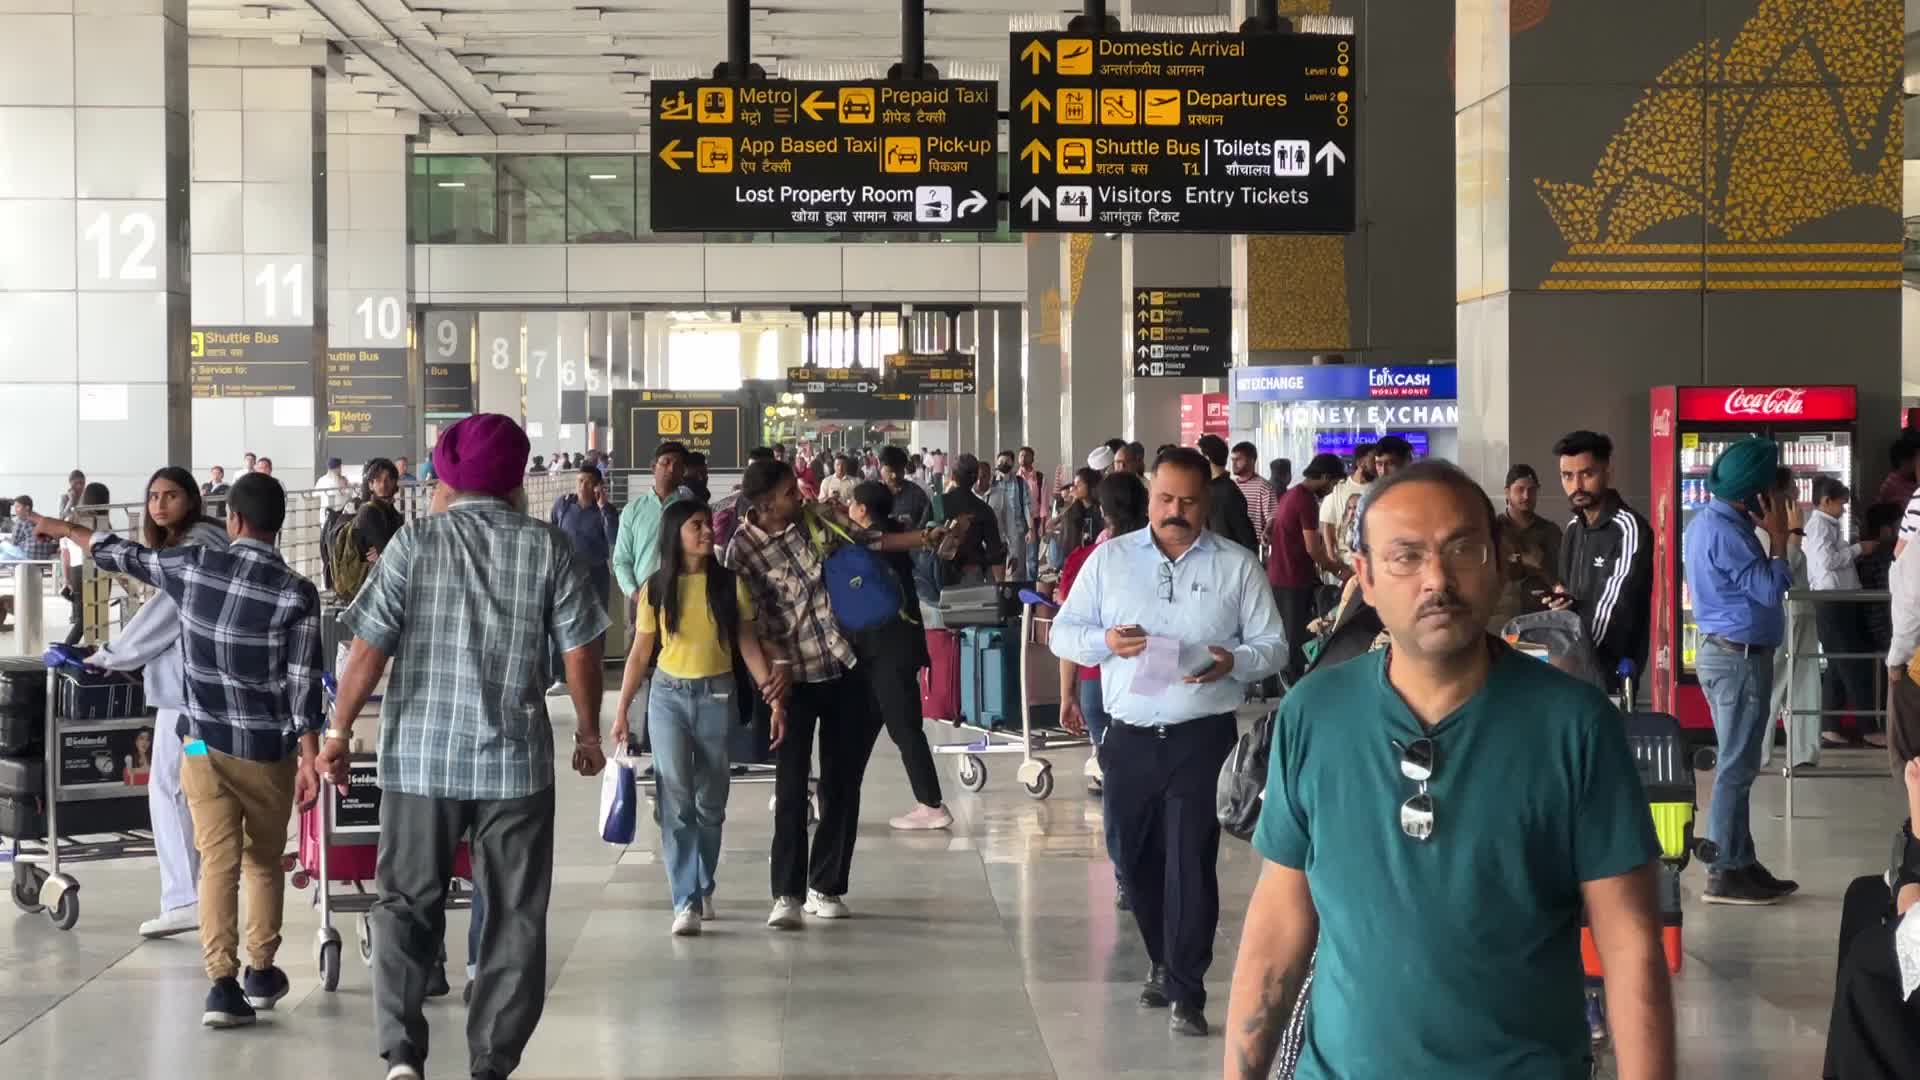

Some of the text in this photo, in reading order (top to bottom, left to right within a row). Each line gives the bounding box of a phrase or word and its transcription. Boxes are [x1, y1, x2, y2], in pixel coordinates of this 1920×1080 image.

[1100, 39, 1245, 57] Domestic Arrival
[1166, 64, 1205, 76] आगमन
[1305, 66, 1328, 76] Level
[739, 87, 989, 106] Metro Prepaid Taxi
[1187, 90, 1336, 109] Departures Level 2
[740, 108, 946, 126] मेट्रो प्रीपेड टैक्सी
[1187, 114, 1223, 126] प्रस्थान
[740, 137, 991, 157] App Based Taxi Pick-up
[1096, 138, 1272, 156] Shuttle Bus Toilets
[740, 158, 968, 174] ऐप टैक्सी पिकअप
[1096, 163, 1148, 176] शटल बस
[1182, 162, 1200, 176] T1
[1225, 160, 1271, 176] शौचालय
[735, 186, 914, 206] Lost Property Room
[1098, 186, 1309, 207] Visitors Entry Tickets
[791, 208, 820, 223] खोया
[825, 210, 847, 226] हुआ
[852, 211, 887, 223] सामान
[1099, 207, 1181, 226] आगंतुक टिकट
[85, 211, 158, 280] 12
[255, 263, 304, 318] 11
[356, 297, 401, 340] 10
[205, 331, 279, 344] Shuttle Bus
[437, 320, 458, 357] 9
[359, 351, 379, 361] Bus
[491, 338, 511, 370] 8
[1192, 344, 1210, 353] Entry
[431, 367, 448, 376] Bus
[532, 351, 548, 379] 7
[562, 360, 576, 386] 6
[1250, 376, 1304, 390] EXCHANGE
[1371, 387, 1428, 395] WORLD MONEY
[1725, 387, 1807, 414] Coca-Cola
[341, 412, 372, 422] Metro
[1275, 407, 1355, 424] MONEY
